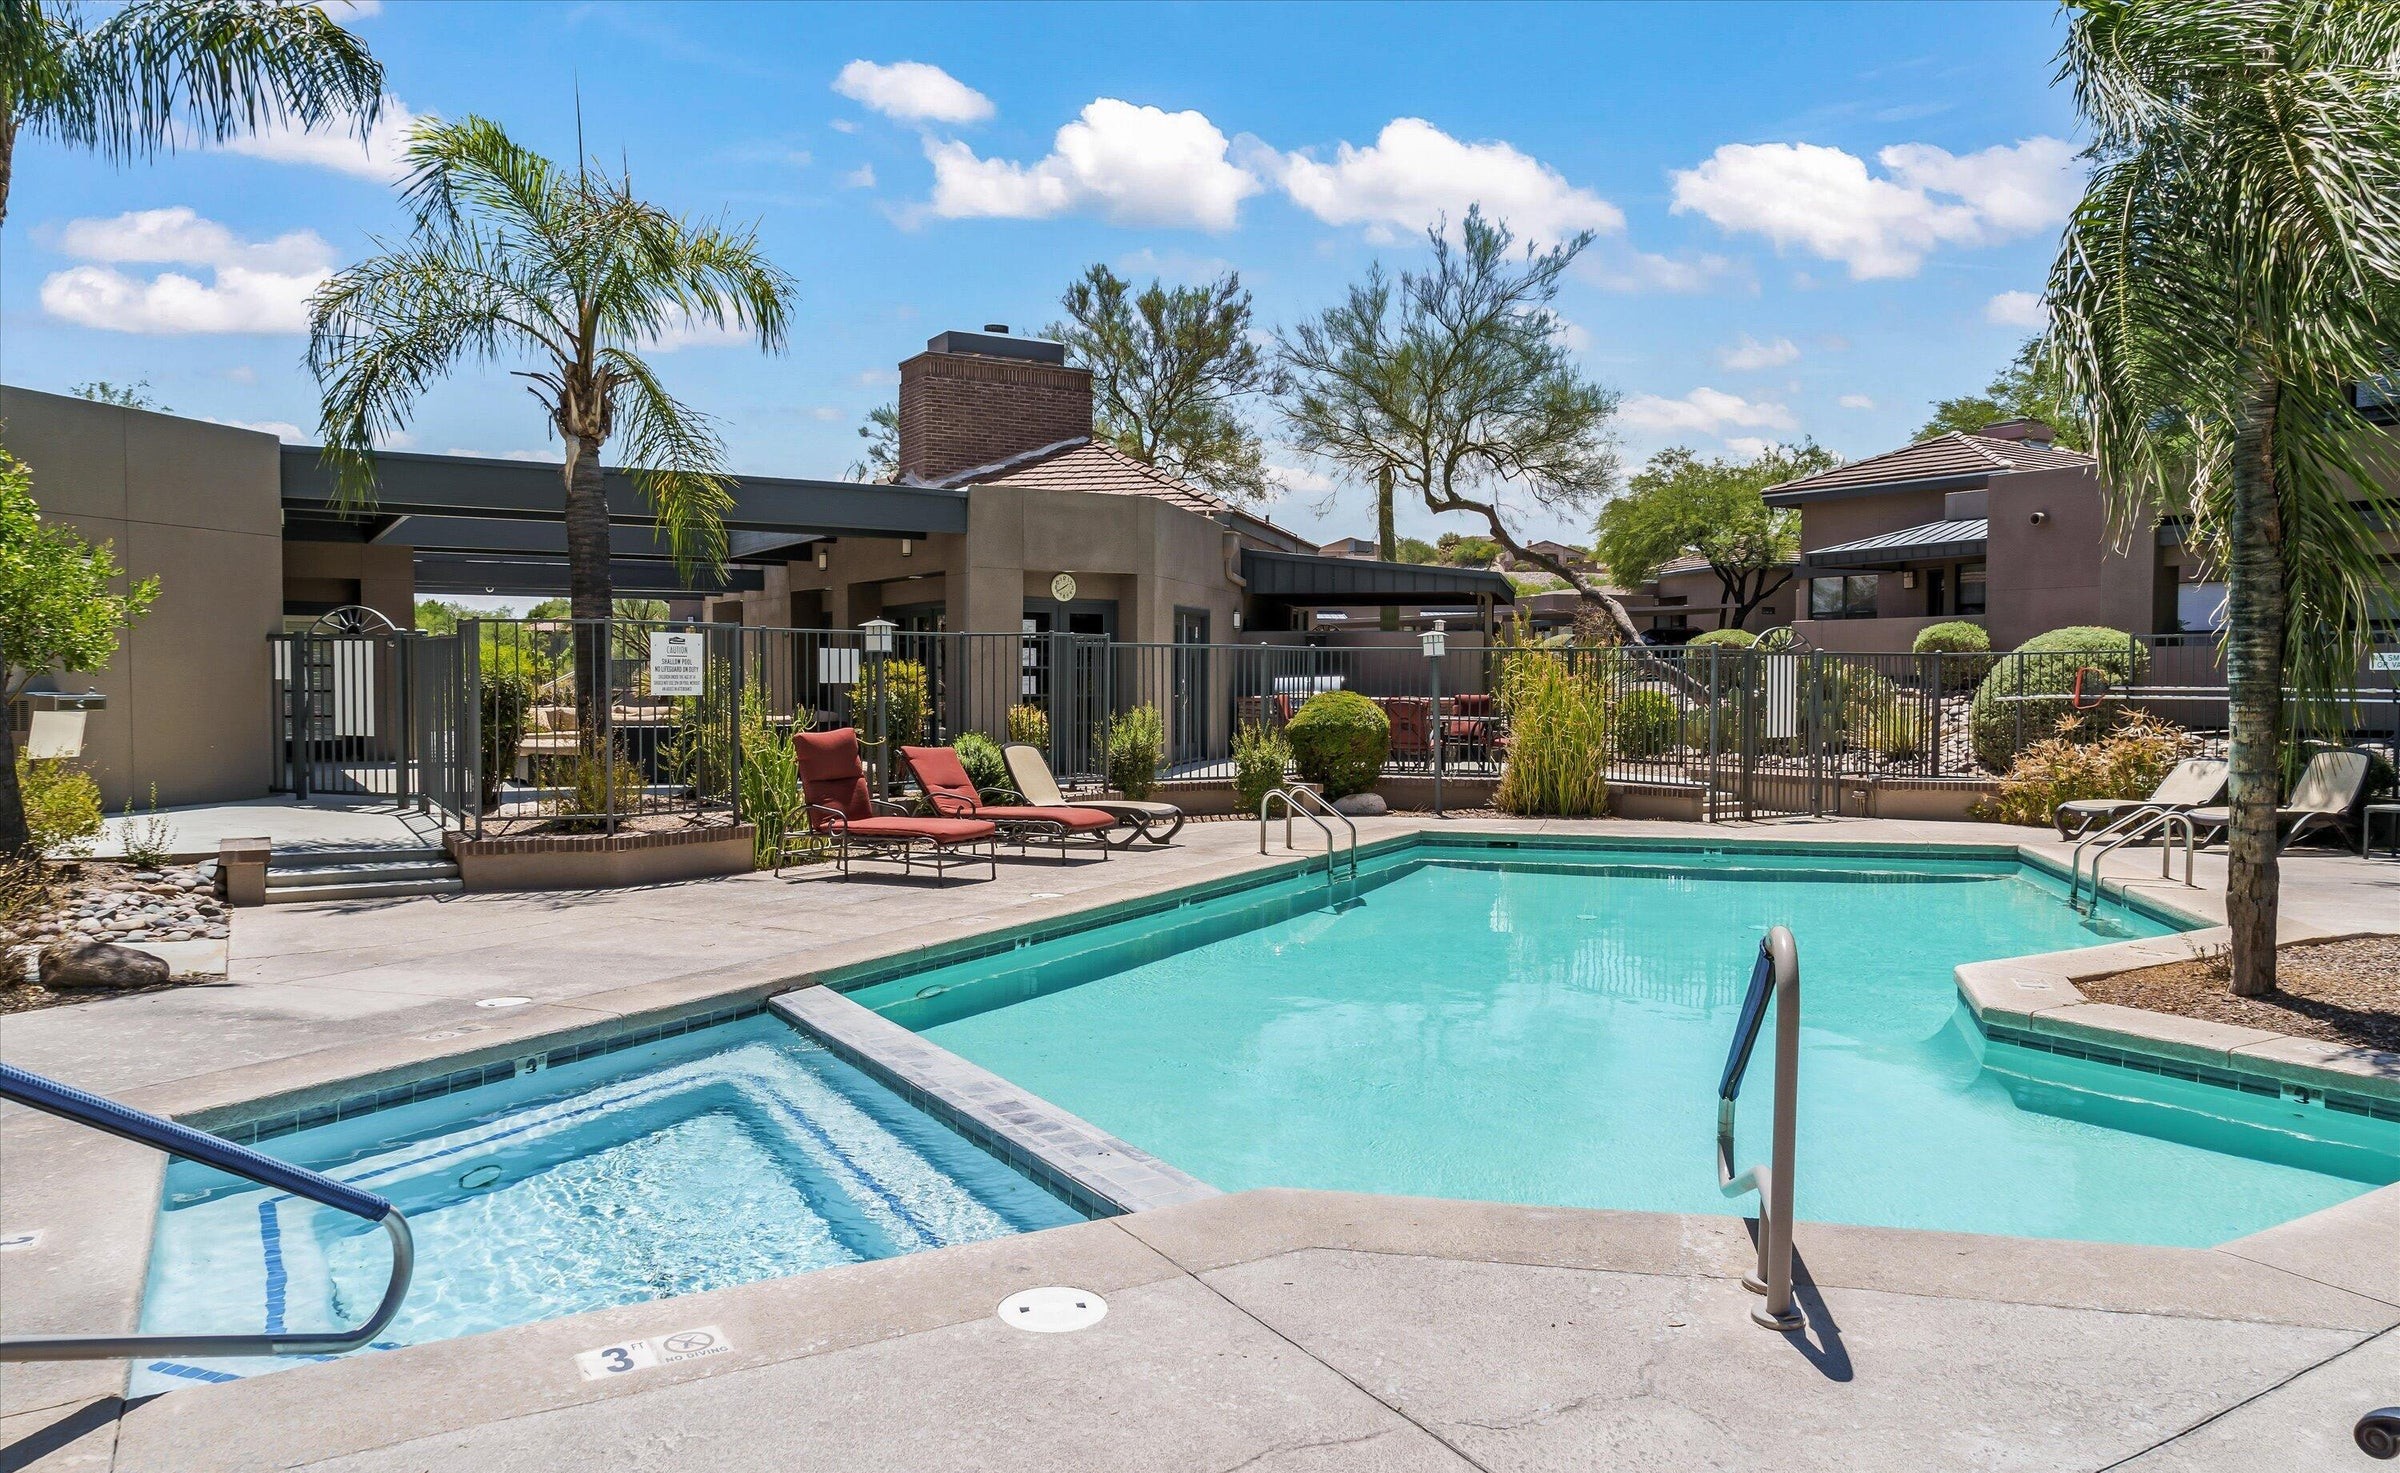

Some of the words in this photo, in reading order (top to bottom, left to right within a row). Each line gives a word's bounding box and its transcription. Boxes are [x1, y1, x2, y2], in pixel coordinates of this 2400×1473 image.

[667, 646, 688, 654] CAUTION
[602, 1348, 634, 1372] 3
[630, 1341, 645, 1351] FT
[665, 1354, 683, 1363] NO
[686, 1346, 729, 1359] DIVING
